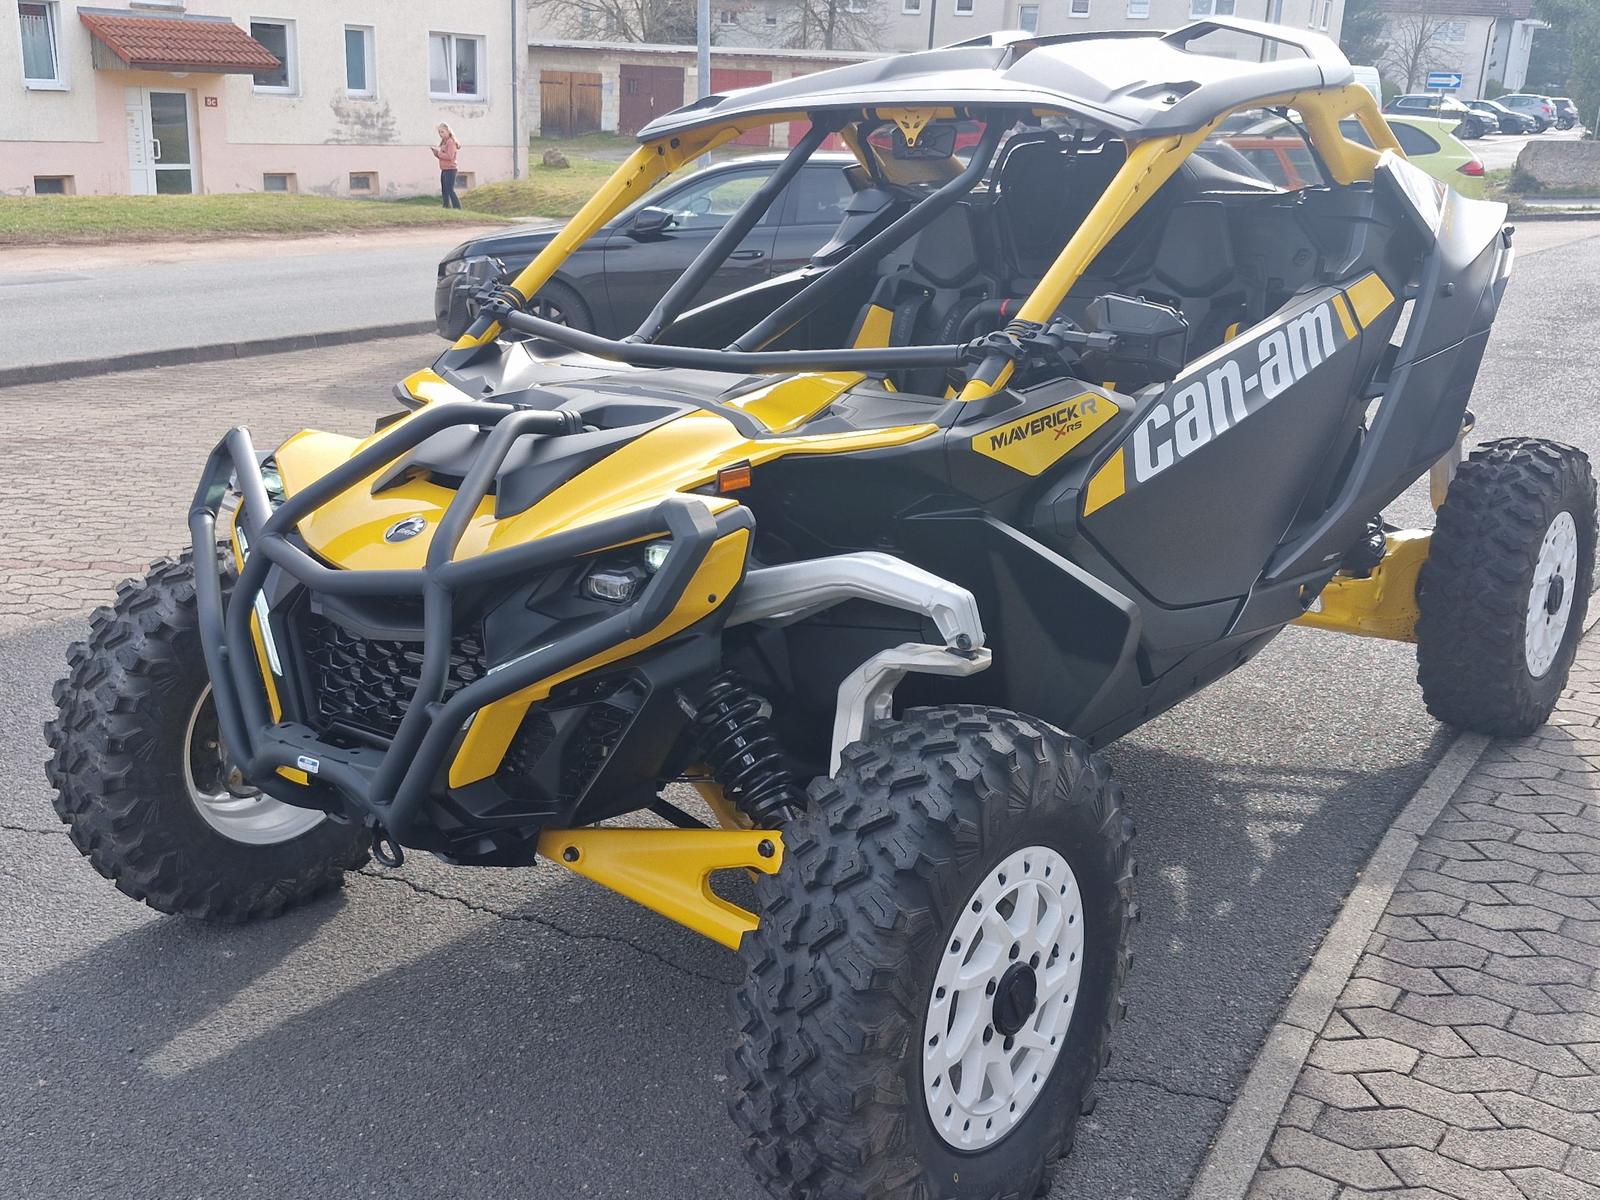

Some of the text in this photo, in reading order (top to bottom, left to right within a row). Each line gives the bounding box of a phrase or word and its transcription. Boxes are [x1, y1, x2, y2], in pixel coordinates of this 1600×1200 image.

[1133, 302, 1337, 484] can-am
[990, 398, 1098, 451] MAVERICK R
[1053, 420, 1083, 441] XRS
